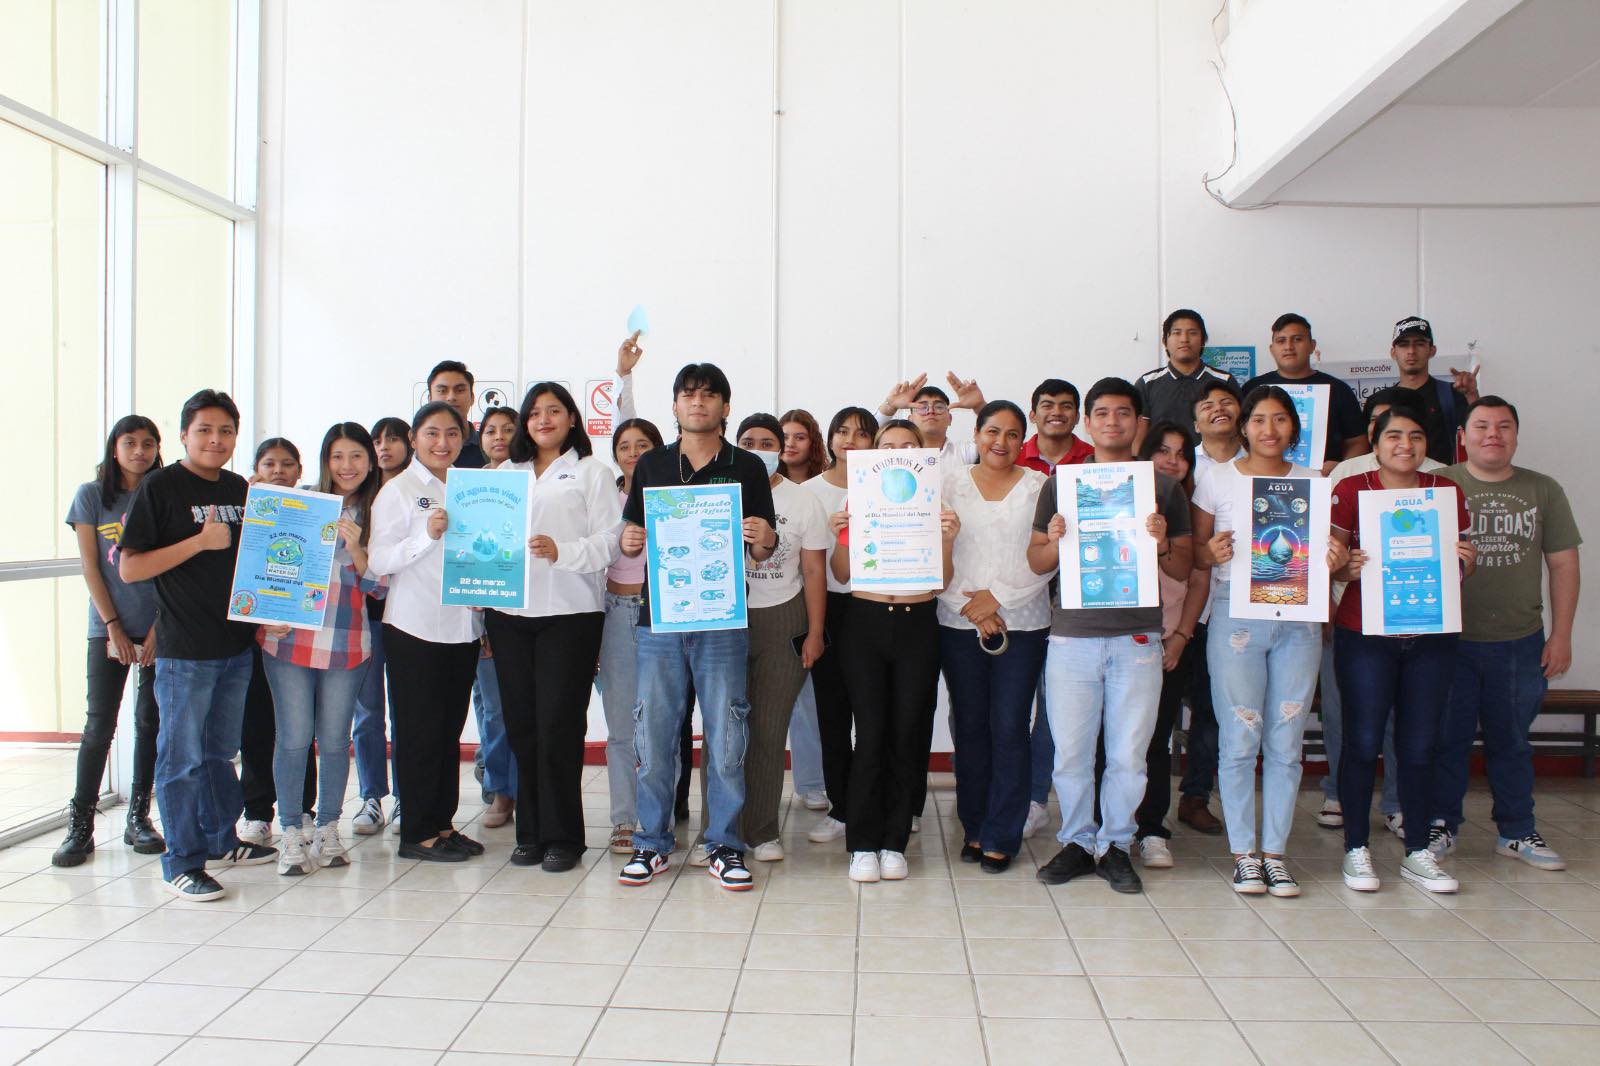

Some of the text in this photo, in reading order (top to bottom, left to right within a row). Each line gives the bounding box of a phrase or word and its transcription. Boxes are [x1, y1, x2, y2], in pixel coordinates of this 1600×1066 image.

[1350, 364, 1391, 373] EDUCACIÓN
[678, 500, 731, 509] Cuidado
[1395, 498, 1423, 507] AGUA
[1470, 506, 1537, 541] LD COAST
[1476, 553, 1521, 567] URFER
